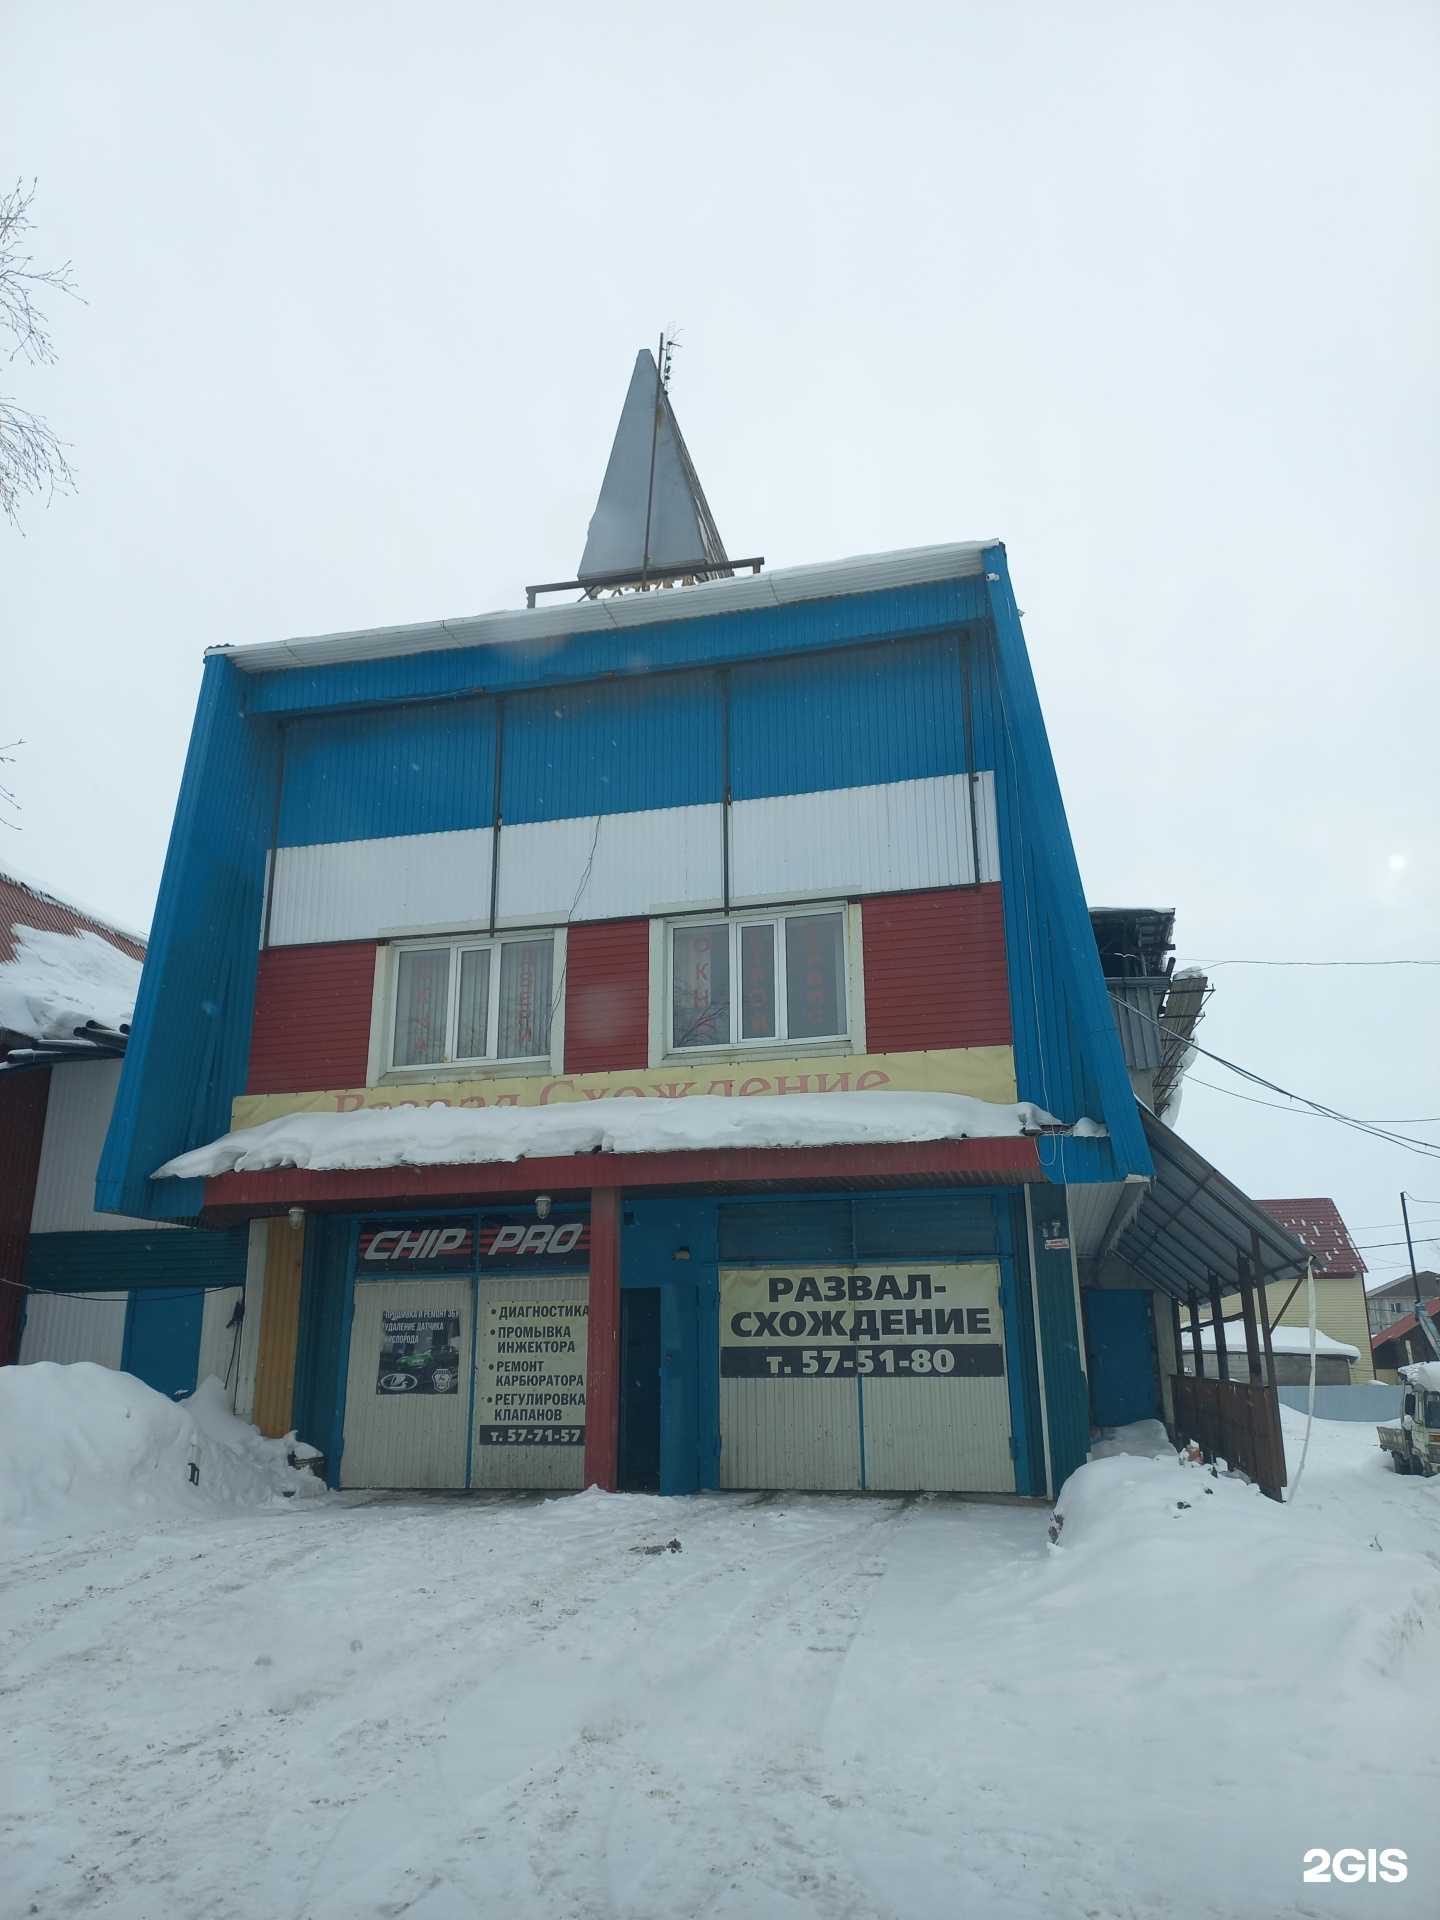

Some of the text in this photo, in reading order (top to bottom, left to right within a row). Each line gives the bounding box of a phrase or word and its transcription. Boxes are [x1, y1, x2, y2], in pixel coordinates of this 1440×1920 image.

[363, 1223, 584, 1260] CHIP PRO
[768, 1274, 947, 1303] РАЗВАЛ-
[499, 1304, 589, 1319] ДИАГНОСТИКА
[730, 1308, 992, 1341] СХОЖДЕНИЕ
[498, 1326, 571, 1339] ПРОМЫВКА
[497, 1340, 576, 1354] ИНЖЕКТОРА
[496, 1361, 545, 1373] РЕМОНТ
[766, 1349, 955, 1374] т. 57-51-80
[495, 1374, 584, 1387] КАРБЮРАТОРА
[495, 1393, 586, 1406] РЕГУЛИРОВКА
[494, 1408, 562, 1422] КЛАПАНОВ
[507, 1428, 581, 1443] 57-71-57
